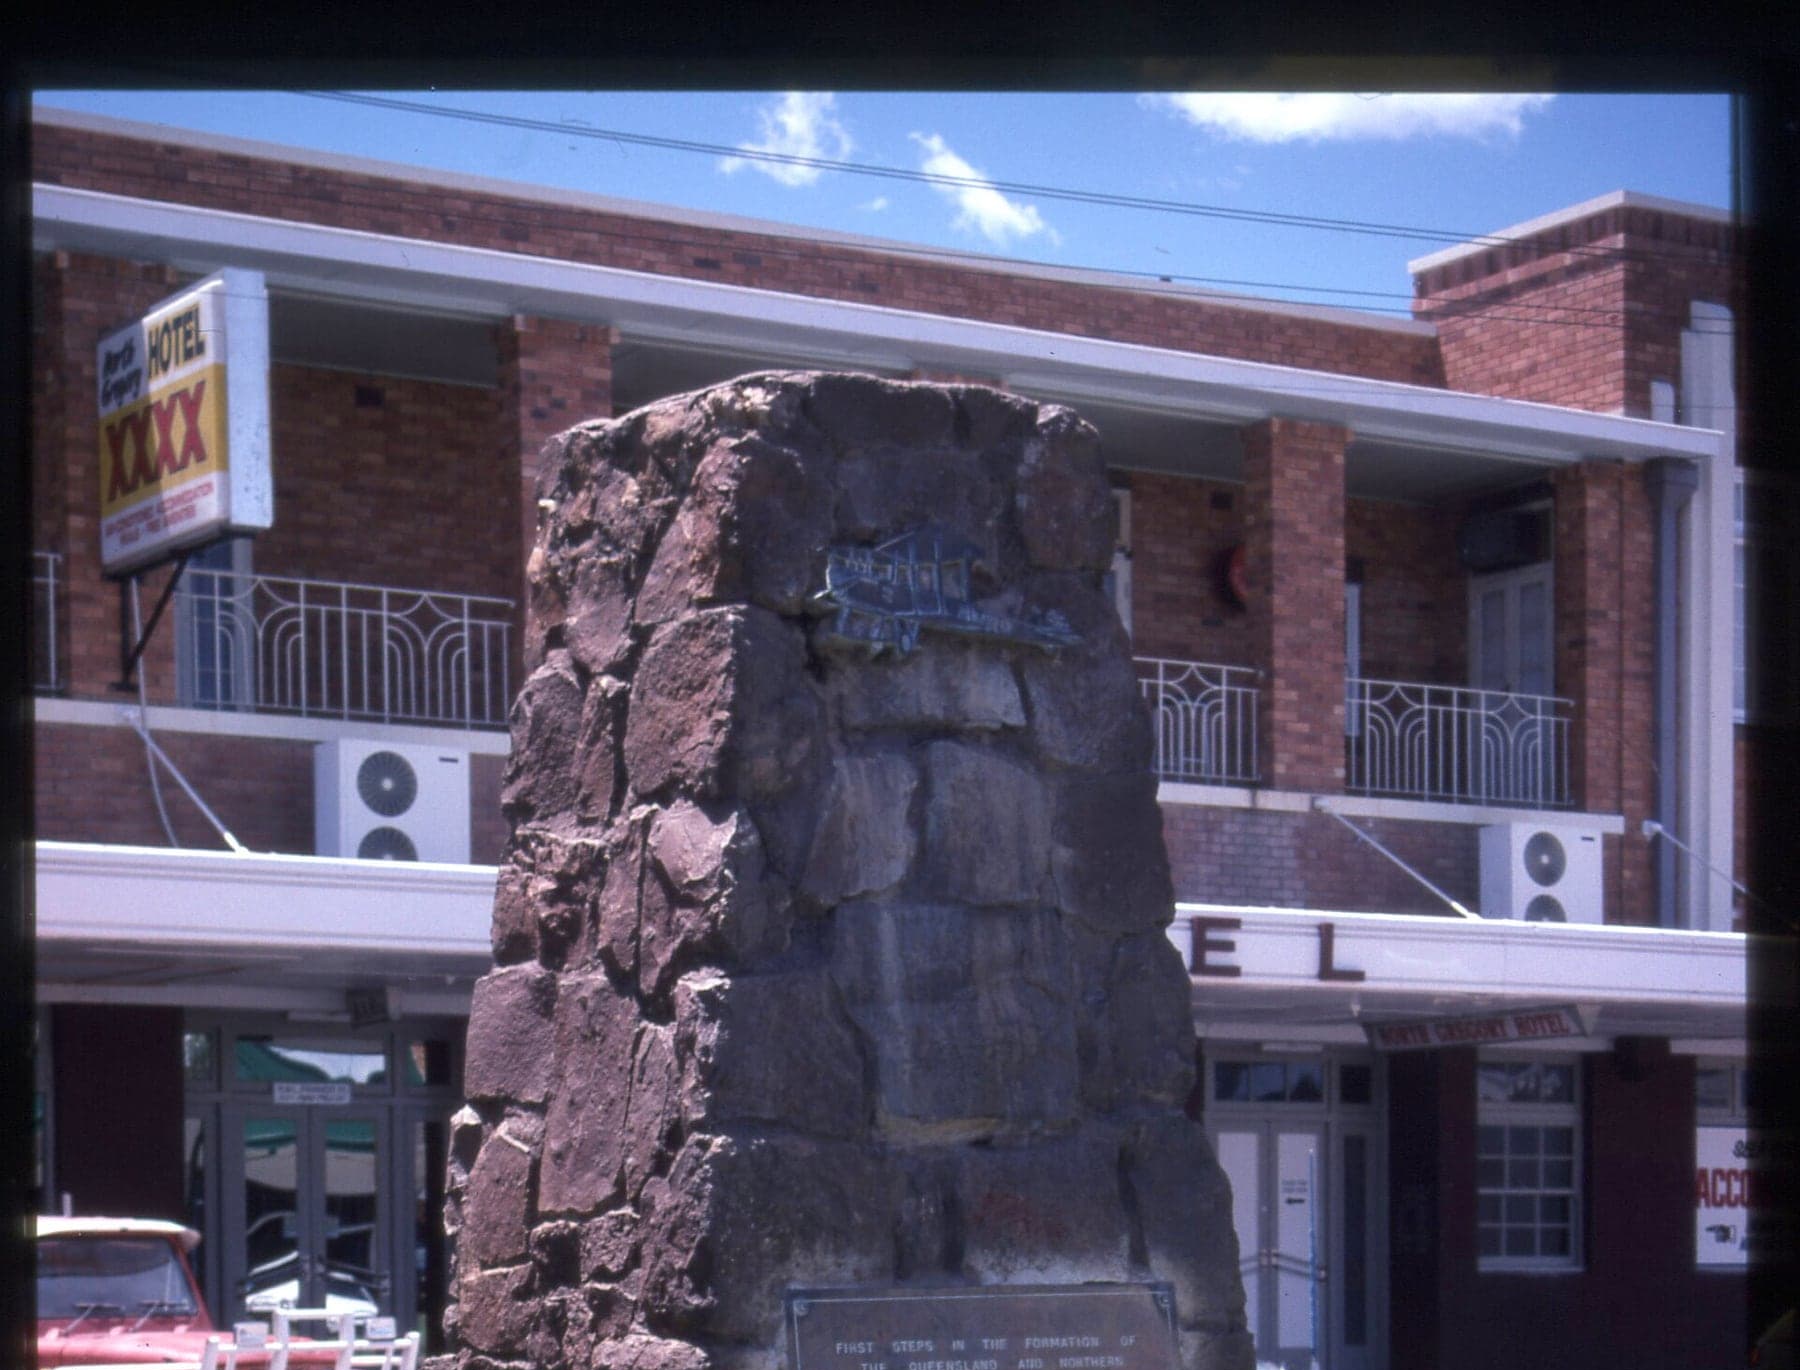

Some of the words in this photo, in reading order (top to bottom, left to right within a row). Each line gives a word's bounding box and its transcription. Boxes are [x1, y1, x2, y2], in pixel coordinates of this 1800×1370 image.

[148, 306, 206, 379] HOTEL
[105, 381, 207, 502] XXXX
[1512, 1011, 1570, 1037] HOTEL
[836, 1342, 874, 1354] FIRST
[892, 1340, 933, 1353] STEPS
[952, 1340, 965, 1350] IN
[983, 1339, 1007, 1350] THE
[1025, 1337, 1099, 1349] FORMATION
[1121, 1335, 1136, 1346] OF
[1018, 1359, 1042, 1369] AND
[1059, 1357, 1123, 1368] NORTHERN
